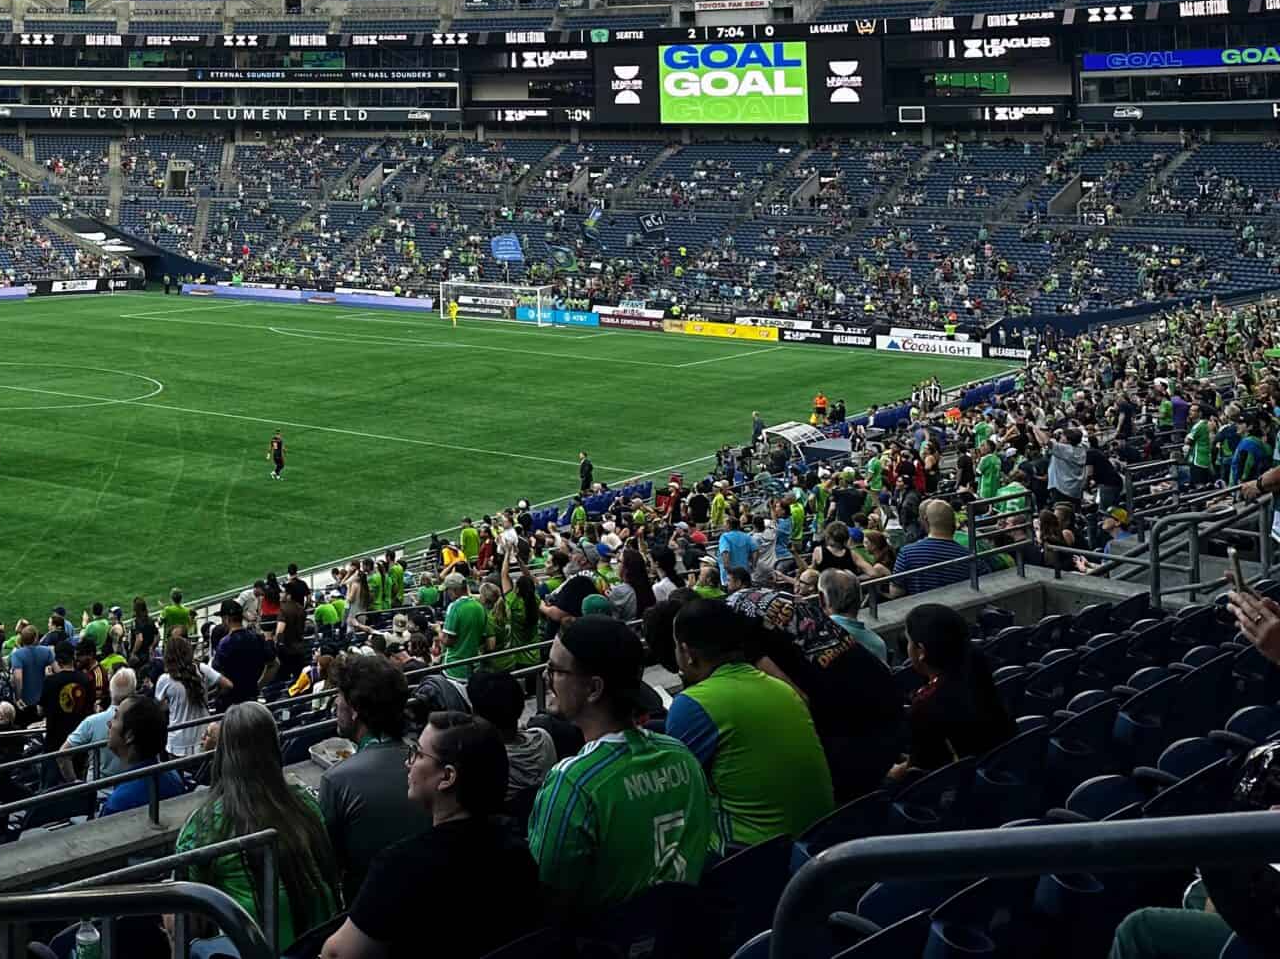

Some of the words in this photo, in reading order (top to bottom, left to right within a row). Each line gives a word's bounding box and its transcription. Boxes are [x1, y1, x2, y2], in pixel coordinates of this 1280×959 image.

[616, 31, 644, 40] SEATTLE
[688, 29, 696, 39] 2
[716, 27, 744, 38] 7:04
[765, 26, 774, 36] 0
[663, 43, 802, 69] GOAL
[1106, 51, 1182, 69] GOAL
[210, 71, 244, 79] ETERNAL
[247, 71, 285, 79] SOUNDERS
[391, 71, 432, 79] SOUNDERS
[663, 71, 803, 98] GOAL
[50, 107, 156, 119] WELCOME
[173, 108, 196, 120] TO
[214, 109, 287, 121] LUMEN
[304, 109, 368, 121] FIELD
[902, 337, 937, 352] Coors
[939, 345, 974, 355] LIGHT
[623, 760, 690, 800] NOUHOU
[648, 809, 687, 886] 5
